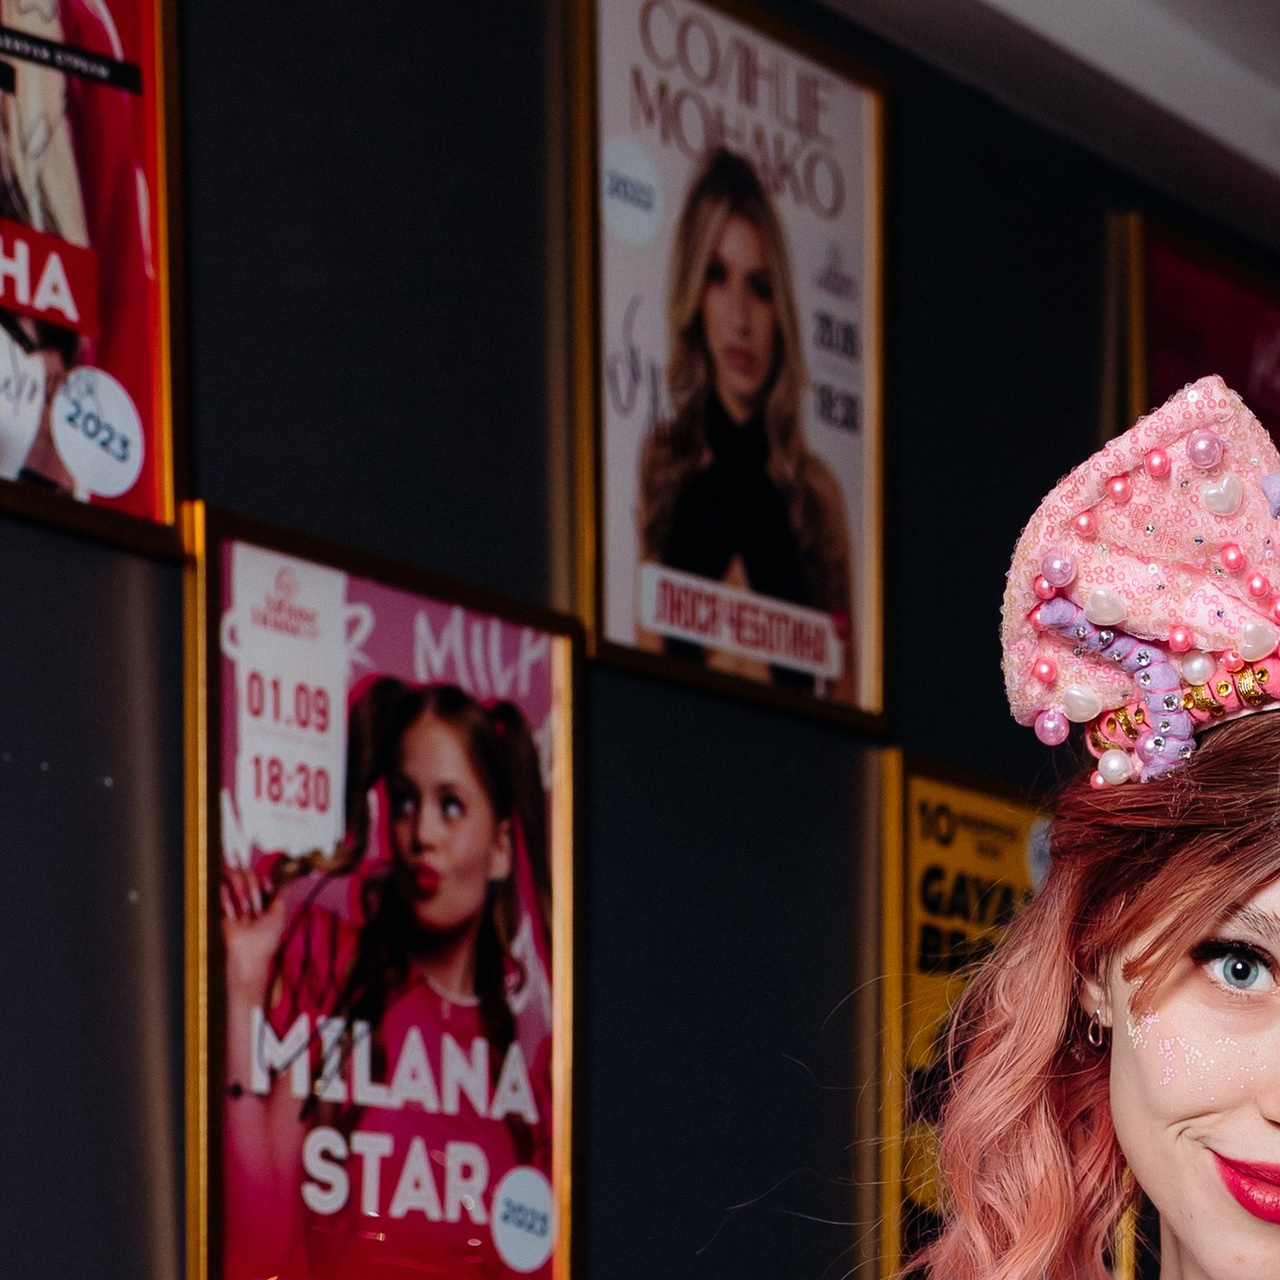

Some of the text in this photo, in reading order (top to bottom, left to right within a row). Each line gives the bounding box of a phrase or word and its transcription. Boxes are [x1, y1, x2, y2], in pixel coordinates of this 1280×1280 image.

[66, 399, 130, 463] 2023
[246, 669, 331, 733] 01.09
[252, 755, 331, 815] 18:30
[921, 865, 1033, 928] GAYA
[250, 1006, 540, 1124] MILANA
[301, 1125, 490, 1226] STAR
